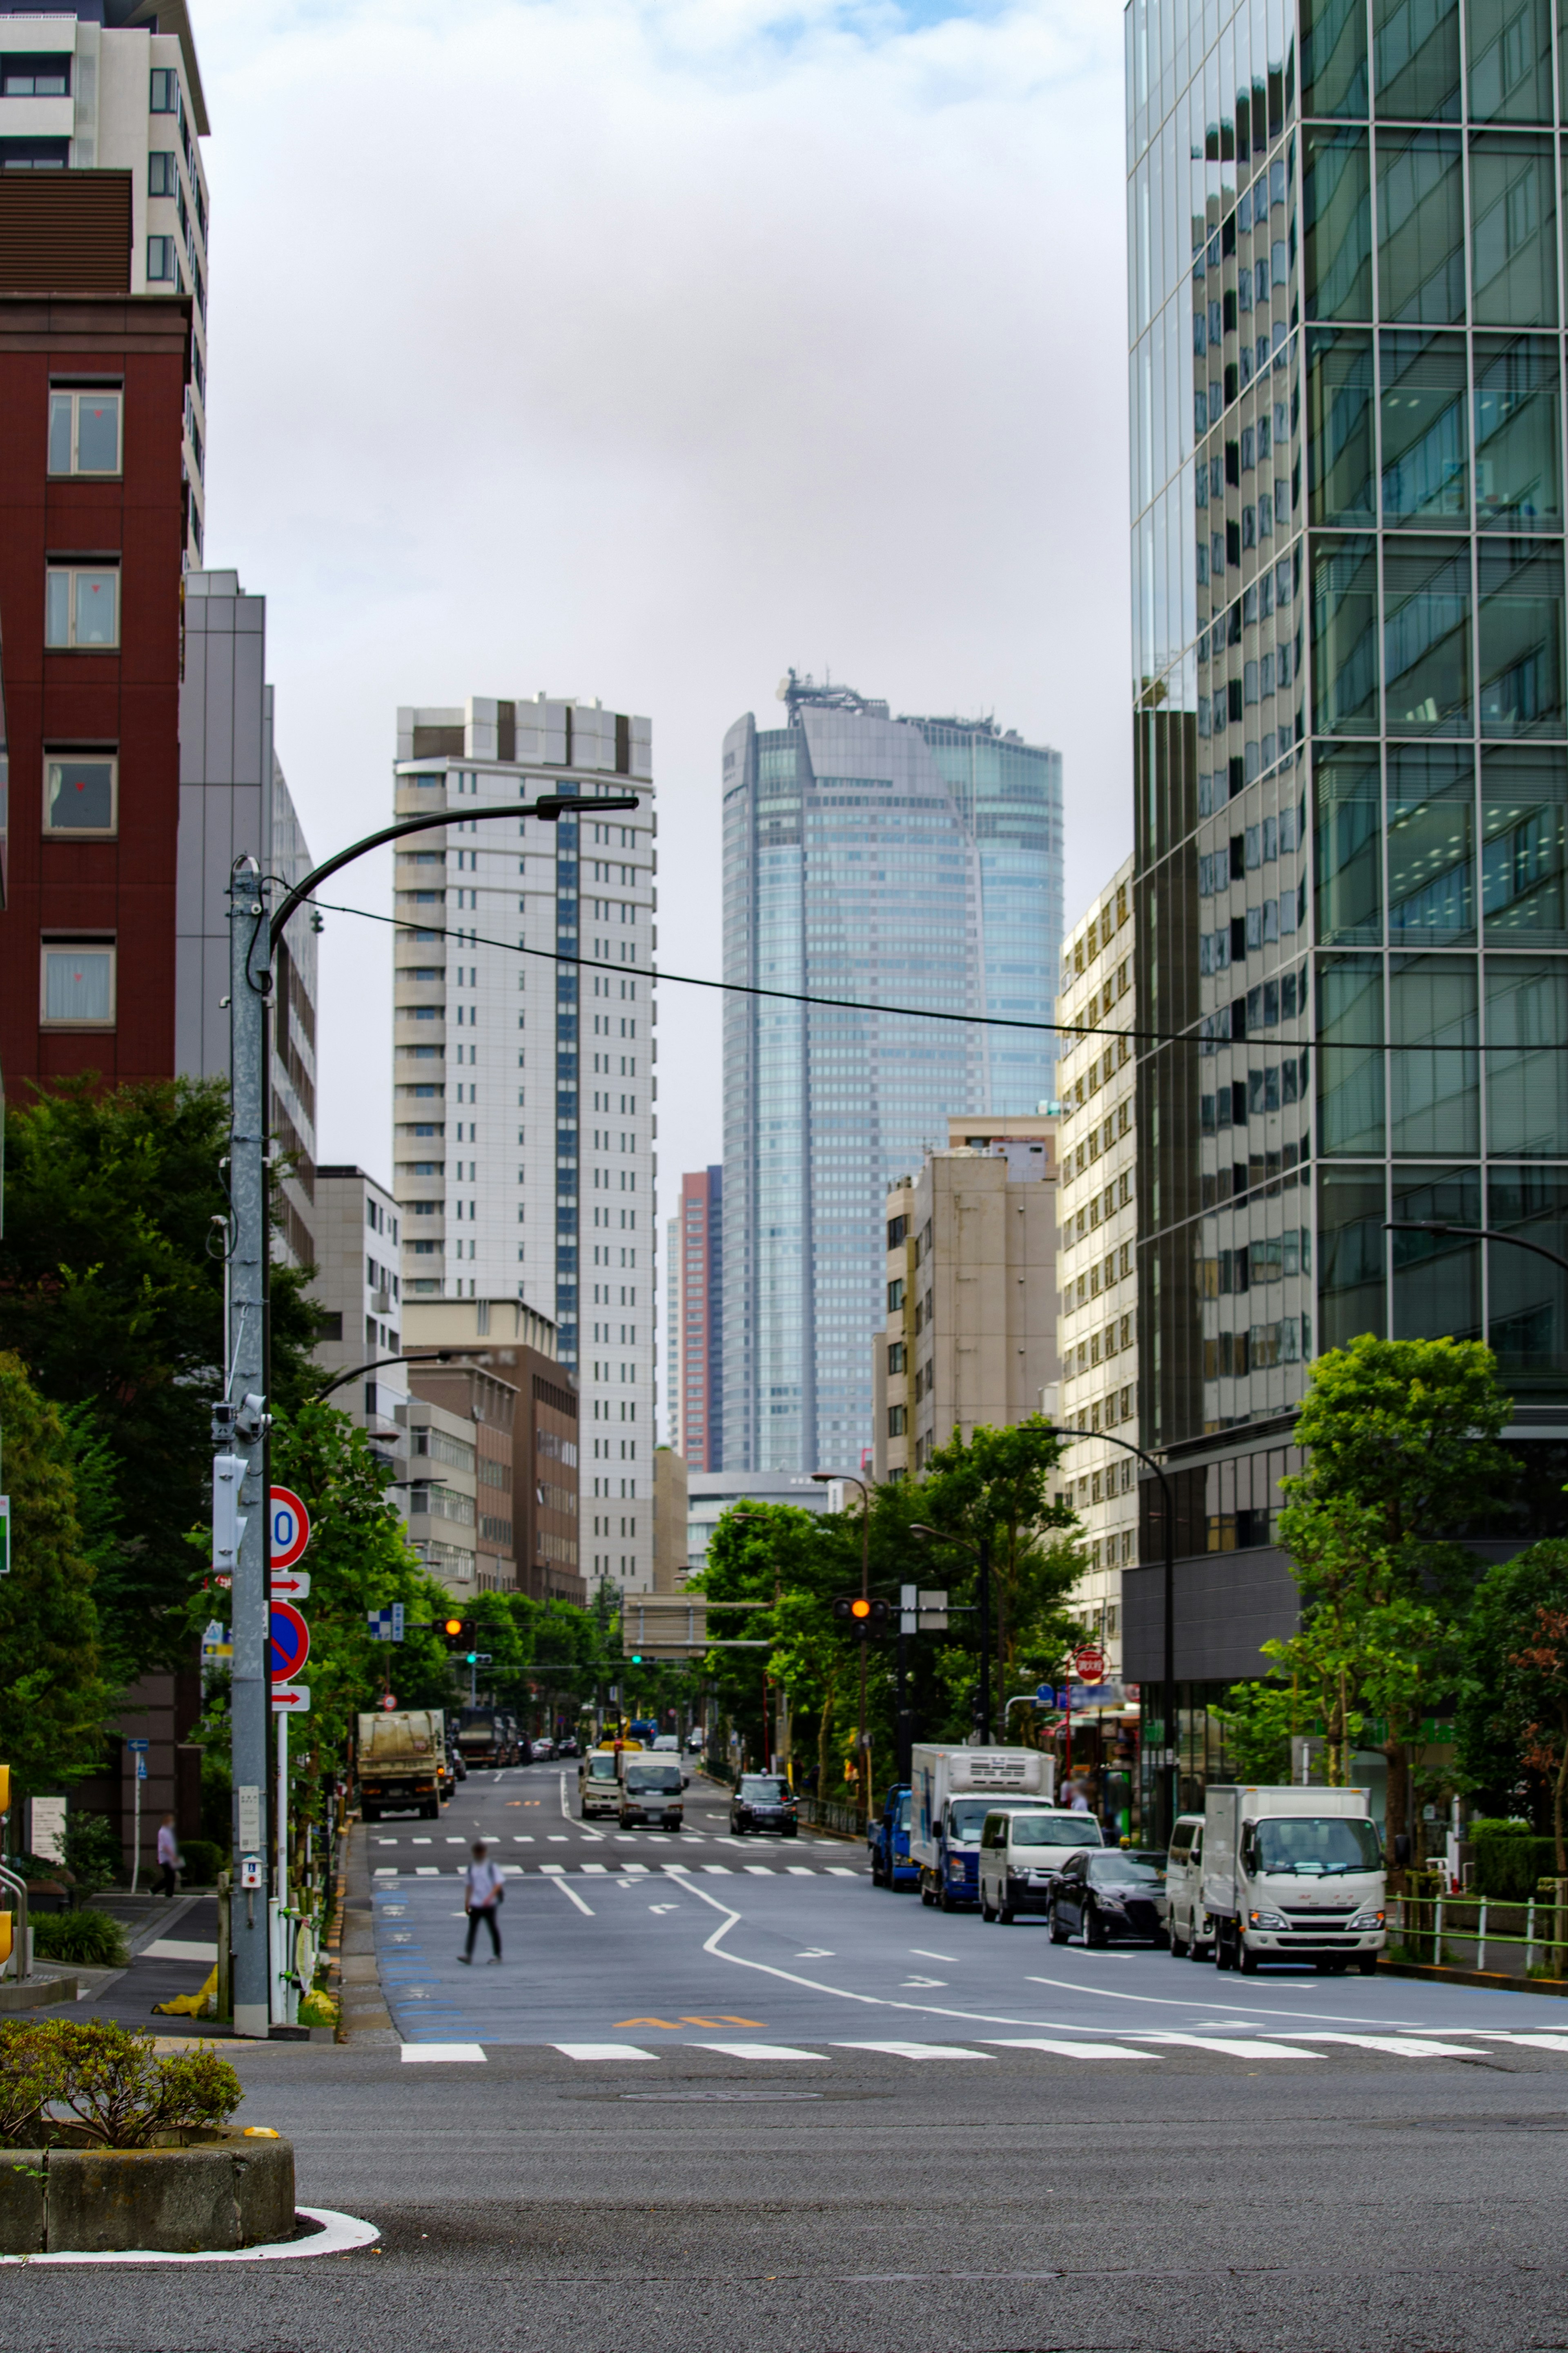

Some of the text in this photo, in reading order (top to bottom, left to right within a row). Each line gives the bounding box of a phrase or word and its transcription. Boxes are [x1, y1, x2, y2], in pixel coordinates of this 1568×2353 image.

[270, 1511, 292, 1546] 0
[1078, 1660, 1102, 1671] 消火栓
[612, 2016, 770, 2029] 40
